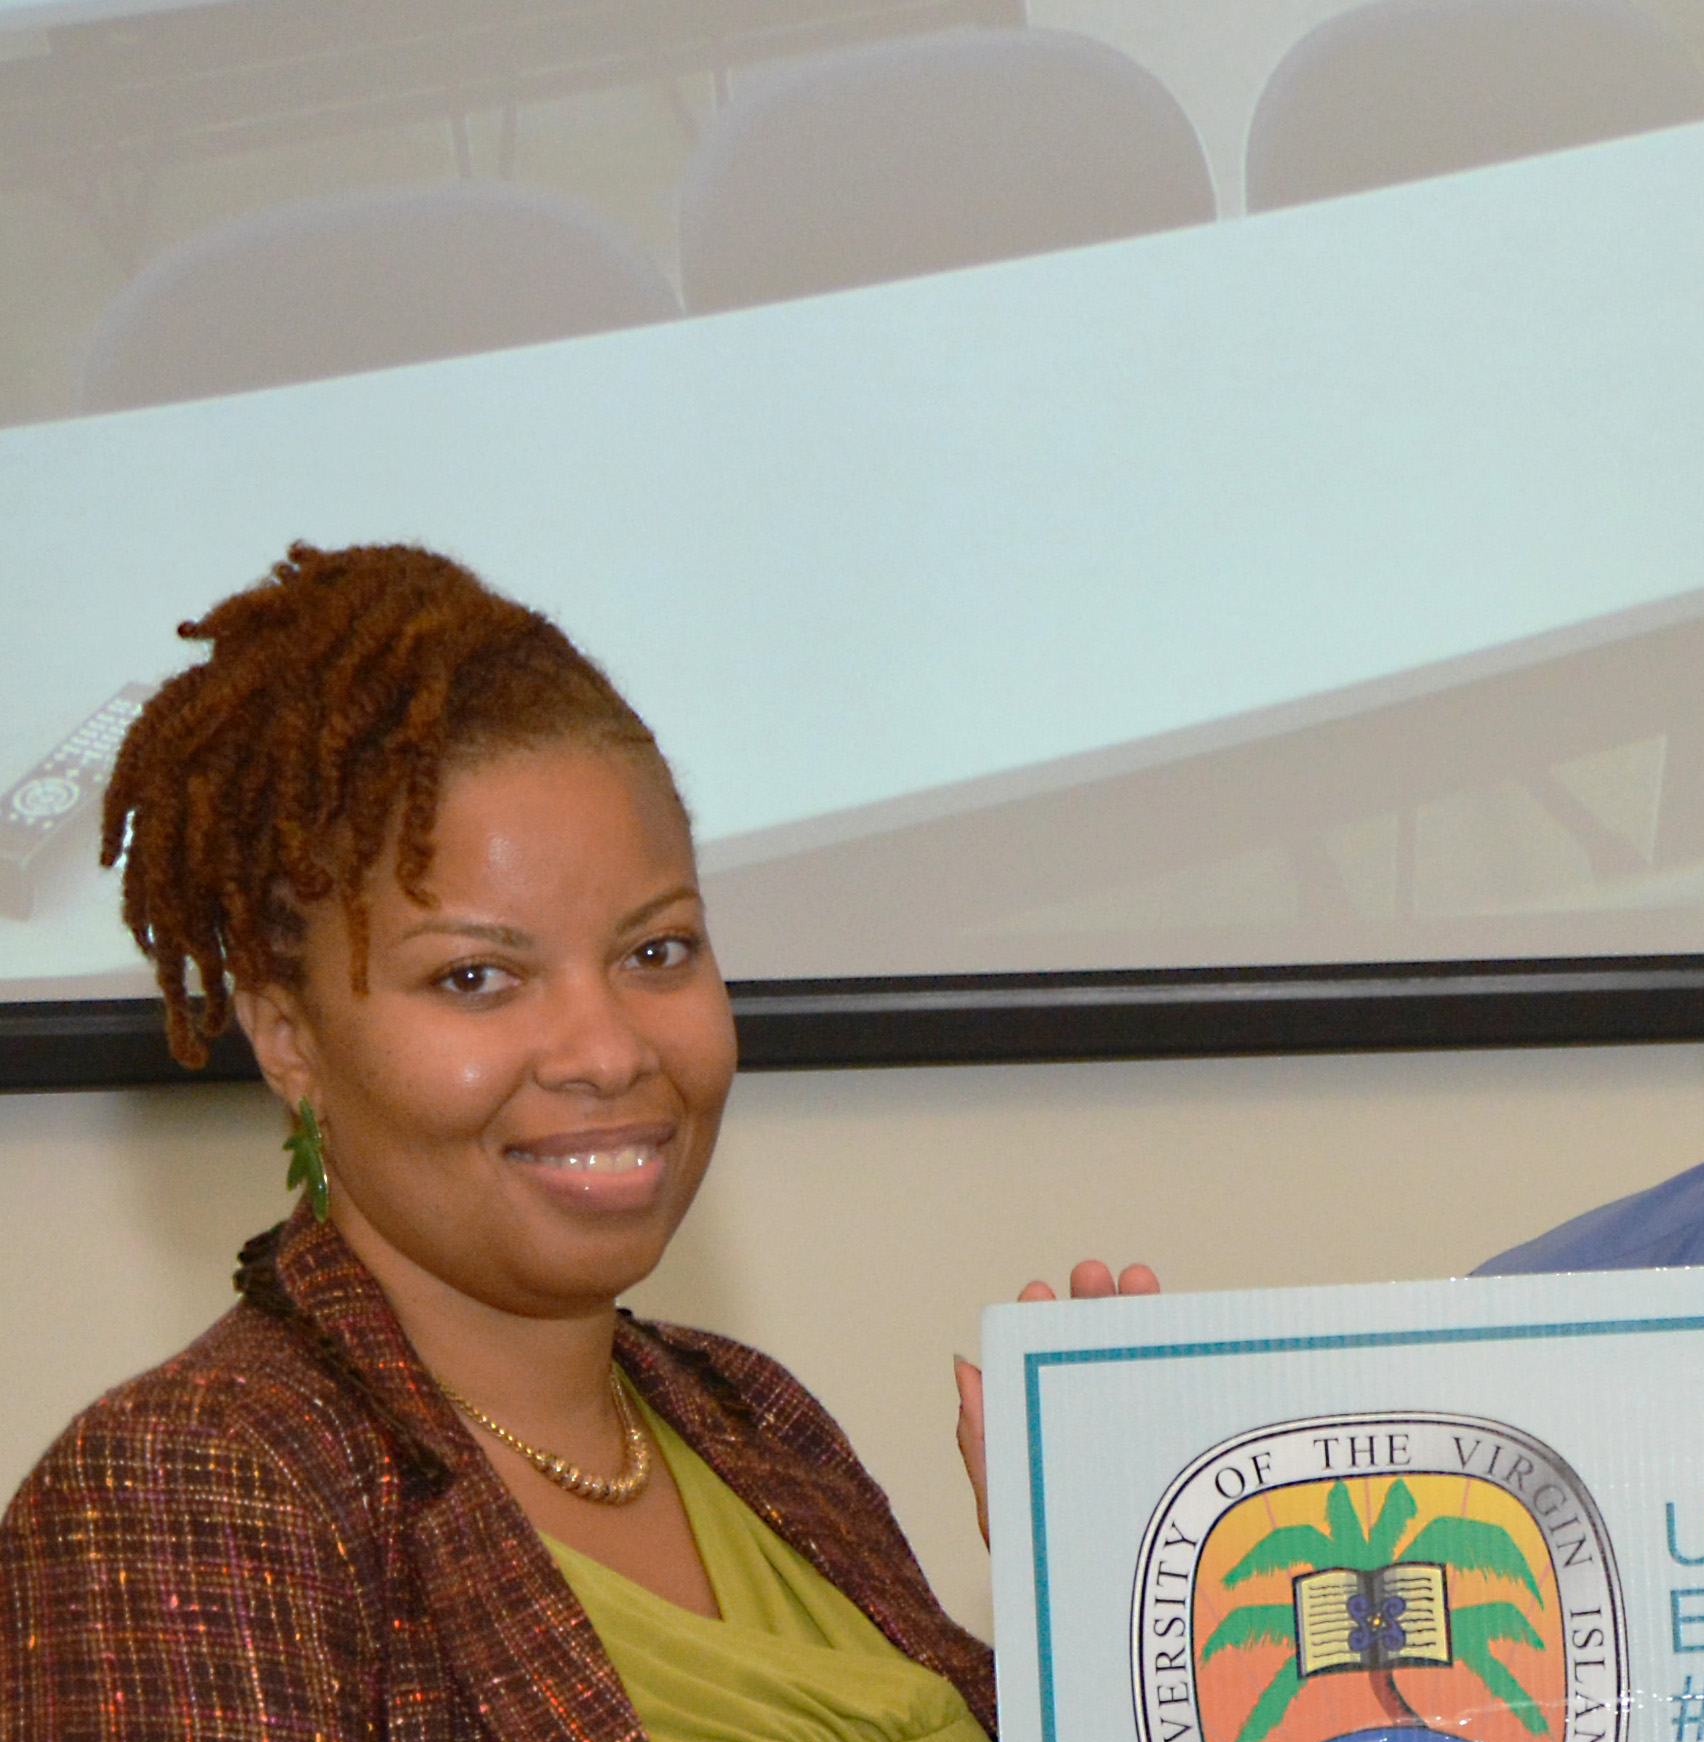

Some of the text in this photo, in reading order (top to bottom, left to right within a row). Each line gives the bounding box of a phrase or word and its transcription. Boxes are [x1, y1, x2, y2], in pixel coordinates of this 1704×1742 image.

[1213, 1450, 1276, 1502] OF
[1311, 1432, 1413, 1473] THE
[1452, 1436, 1598, 1570] VIRGIN
